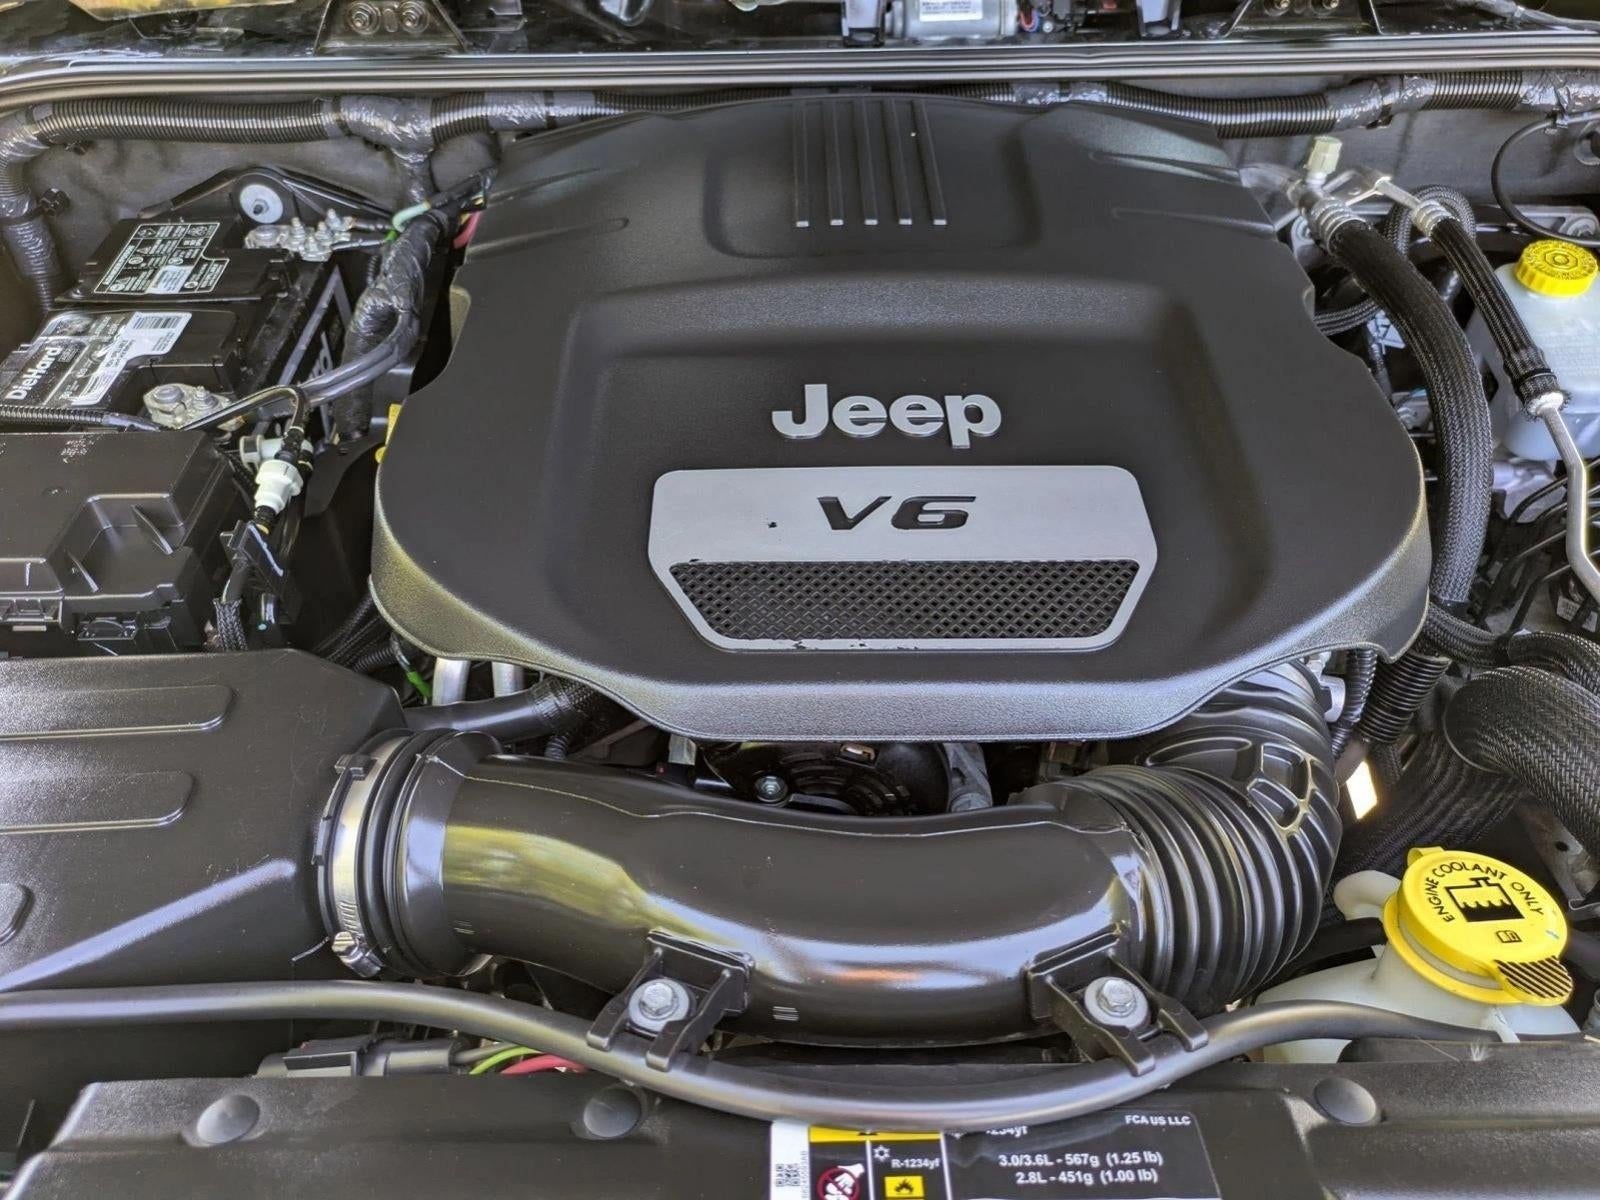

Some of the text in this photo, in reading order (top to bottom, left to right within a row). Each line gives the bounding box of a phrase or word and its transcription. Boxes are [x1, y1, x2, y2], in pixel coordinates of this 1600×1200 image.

[5, 346, 62, 400] DieHard
[771, 383, 1002, 449] Jeep
[817, 495, 977, 530] V6
[1424, 861, 1544, 923] ENGINE COOLANT ONLY
[1124, 1115, 1191, 1126] FCA US LLC
[891, 1158, 940, 1170] R-1234yf
[998, 1153, 1055, 1167] 3.0/3.6L
[1064, 1153, 1100, 1168] 567g
[1105, 1151, 1141, 1167] (1.25
[1142, 1150, 1164, 1167] lb)
[1015, 1171, 1048, 1185] 2.8L
[1058, 1170, 1095, 1186] 451g
[1099, 1169, 1136, 1185] (1.00
[1137, 1168, 1159, 1184] lb)
